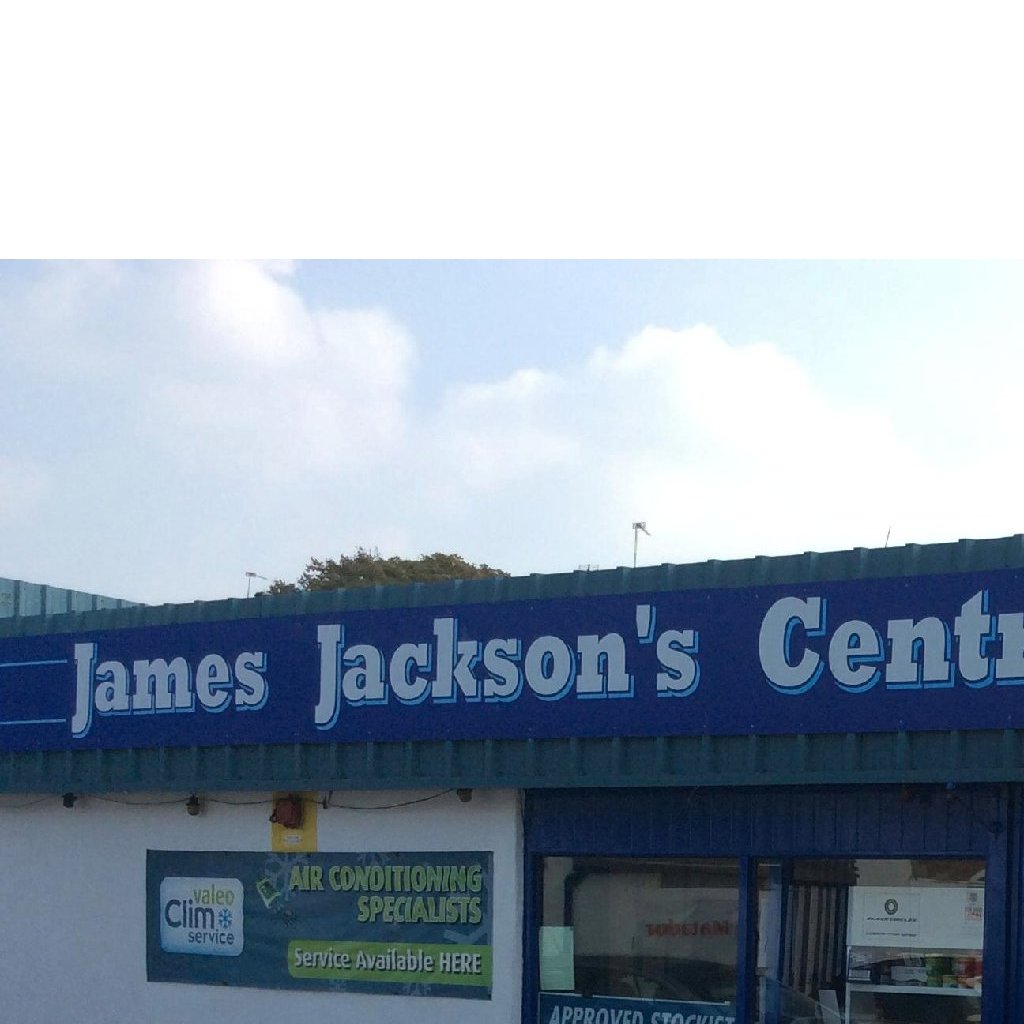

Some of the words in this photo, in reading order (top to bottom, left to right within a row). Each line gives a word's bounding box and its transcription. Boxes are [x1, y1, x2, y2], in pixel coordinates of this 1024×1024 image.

[70, 643, 268, 738] James
[313, 605, 699, 730] Jackson's
[289, 865, 325, 891] AIR
[328, 865, 483, 892] CONDITIONING
[192, 884, 235, 905] valeo
[164, 899, 215, 930] Clim
[357, 896, 483, 924] SPECIALISTS
[187, 930, 235, 946] service
[294, 947, 351, 969] Service
[355, 949, 434, 972] Available
[438, 952, 482, 974] HERE
